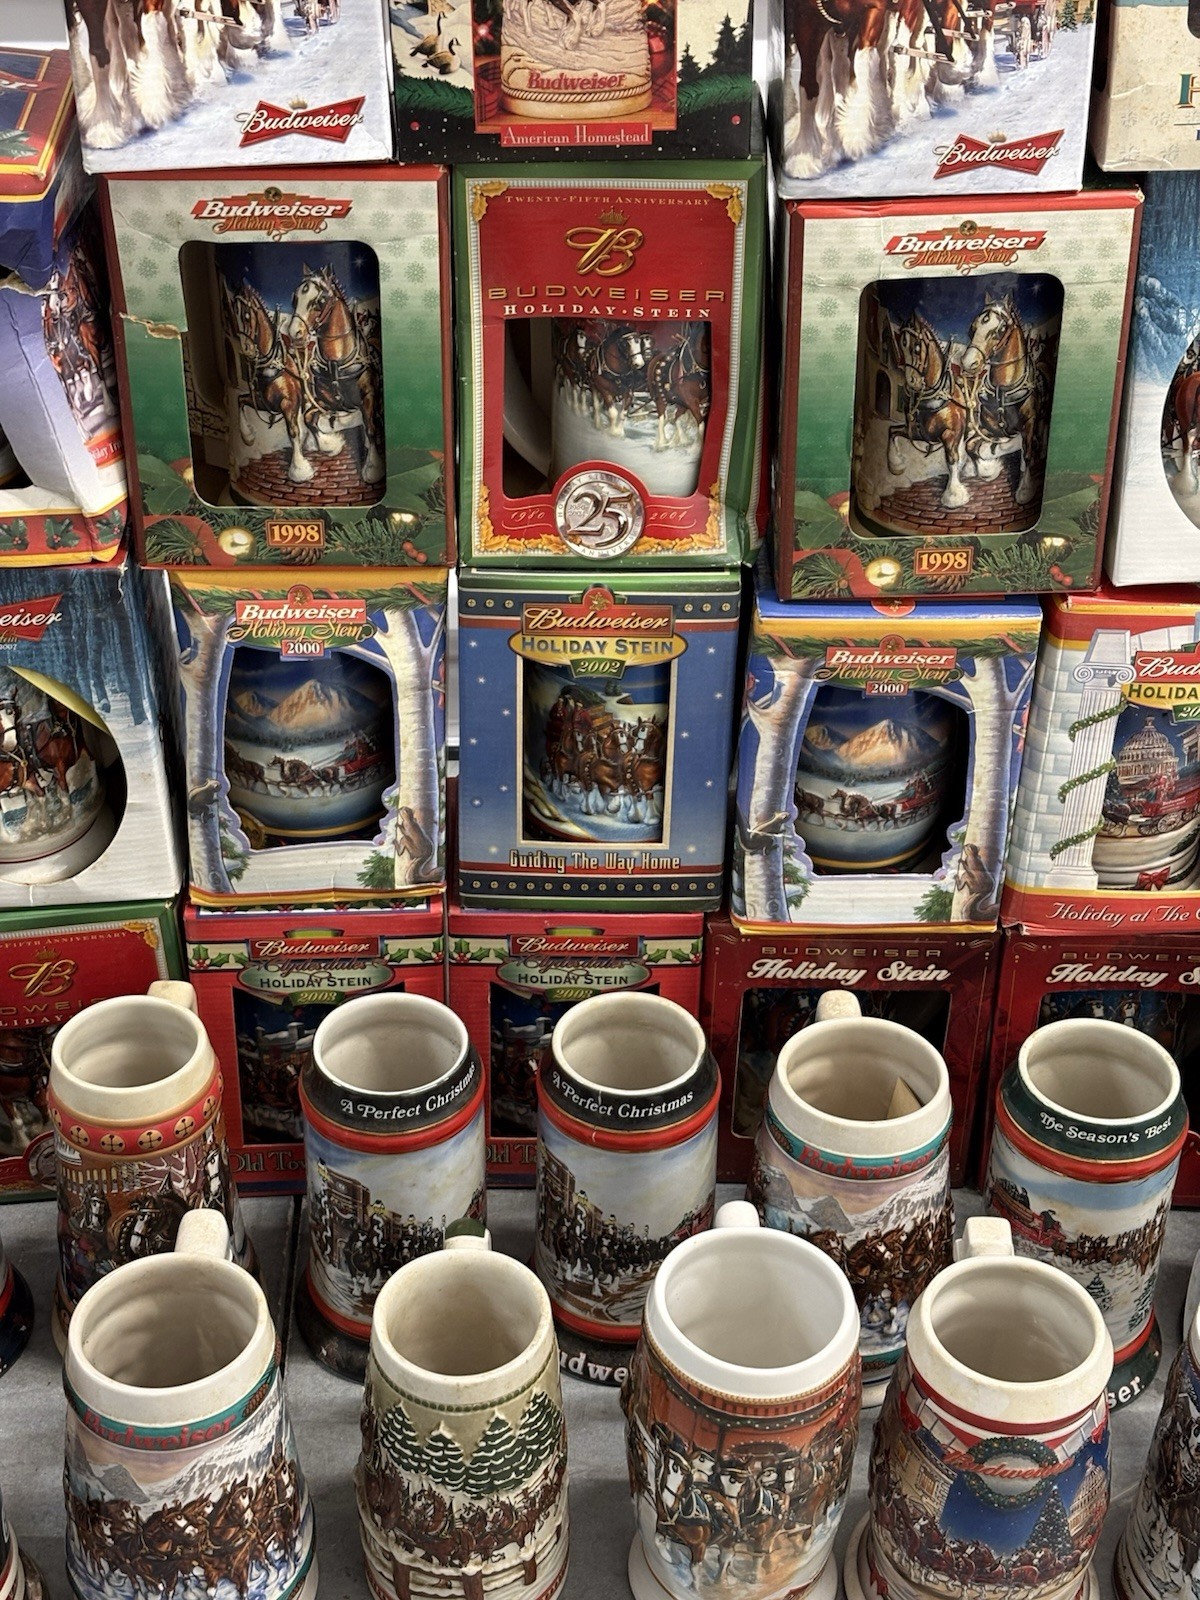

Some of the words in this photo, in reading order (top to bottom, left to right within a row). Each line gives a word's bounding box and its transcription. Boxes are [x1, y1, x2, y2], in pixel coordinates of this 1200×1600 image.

[527, 69, 627, 91] Budweiser
[234, 106, 365, 134] Budweiser
[503, 126, 570, 145] American
[574, 124, 649, 144] Homestead
[932, 140, 1061, 166] Budweiser
[199, 200, 343, 218] Budweiser
[615, 196, 711, 206] ANNIVERSARY
[212, 214, 275, 237] Holiday
[275, 214, 327, 239] Stein
[891, 234, 1037, 253] Budweiser
[903, 249, 966, 270] Holiday
[966, 248, 1019, 273] Stein
[488, 285, 726, 302] BUDWEISER
[567, 490, 634, 548] 25
[270, 524, 320, 543] 1998
[919, 549, 970, 571] 1998
[0, 608, 63, 627] eiser
[240, 604, 365, 620] Budweiser
[524, 606, 669, 631] Budweiser
[224, 618, 306, 643] Holiday
[310, 617, 374, 642] Stein
[286, 642, 321, 655] 2000
[521, 637, 607, 654] HOLIDAY
[615, 638, 674, 655] STEIN
[576, 660, 621, 674] 2002
[829, 650, 955, 665] Budweiser
[812, 663, 894, 684] Holiday
[897, 663, 962, 685] Stein
[871, 683, 905, 694] 2000
[1128, 683, 1199, 699] HOLIDA
[509, 849, 566, 873] Guiding
[571, 852, 598, 870] The
[605, 853, 636, 874] Way
[641, 853, 680, 870] Home
[1046, 902, 1127, 928] Holiday
[1129, 909, 1151, 922] at
[1153, 904, 1190, 922] The
[255, 940, 371, 957] Budweiser
[516, 936, 630, 953] Budweiser
[762, 946, 942, 958] BUDWEISER
[1062, 952, 1200, 963] BUDWEIS
[517, 973, 580, 985] HOLIDAY
[584, 974, 629, 985] STEIN
[747, 958, 867, 985] Holiday
[877, 960, 951, 982] Stein
[1045, 963, 1169, 988] Holiday
[260, 978, 323, 989] HOLIDAY
[327, 976, 372, 988] STEIN
[0, 1014, 64, 1027] LIDAY
[341, 1099, 355, 1115] A
[357, 1103, 421, 1120] Perfect
[425, 1063, 476, 1112] Christmas
[552, 1071, 564, 1090] A
[562, 1083, 614, 1117] Perfect
[617, 1090, 694, 1118] Christmas
[1040, 1111, 1064, 1133] The
[1065, 1125, 1140, 1145] Season's
[1144, 1115, 1173, 1140] Best
[799, 1144, 935, 1179] Budweiser
[83, 1407, 237, 1449] Budweiser
